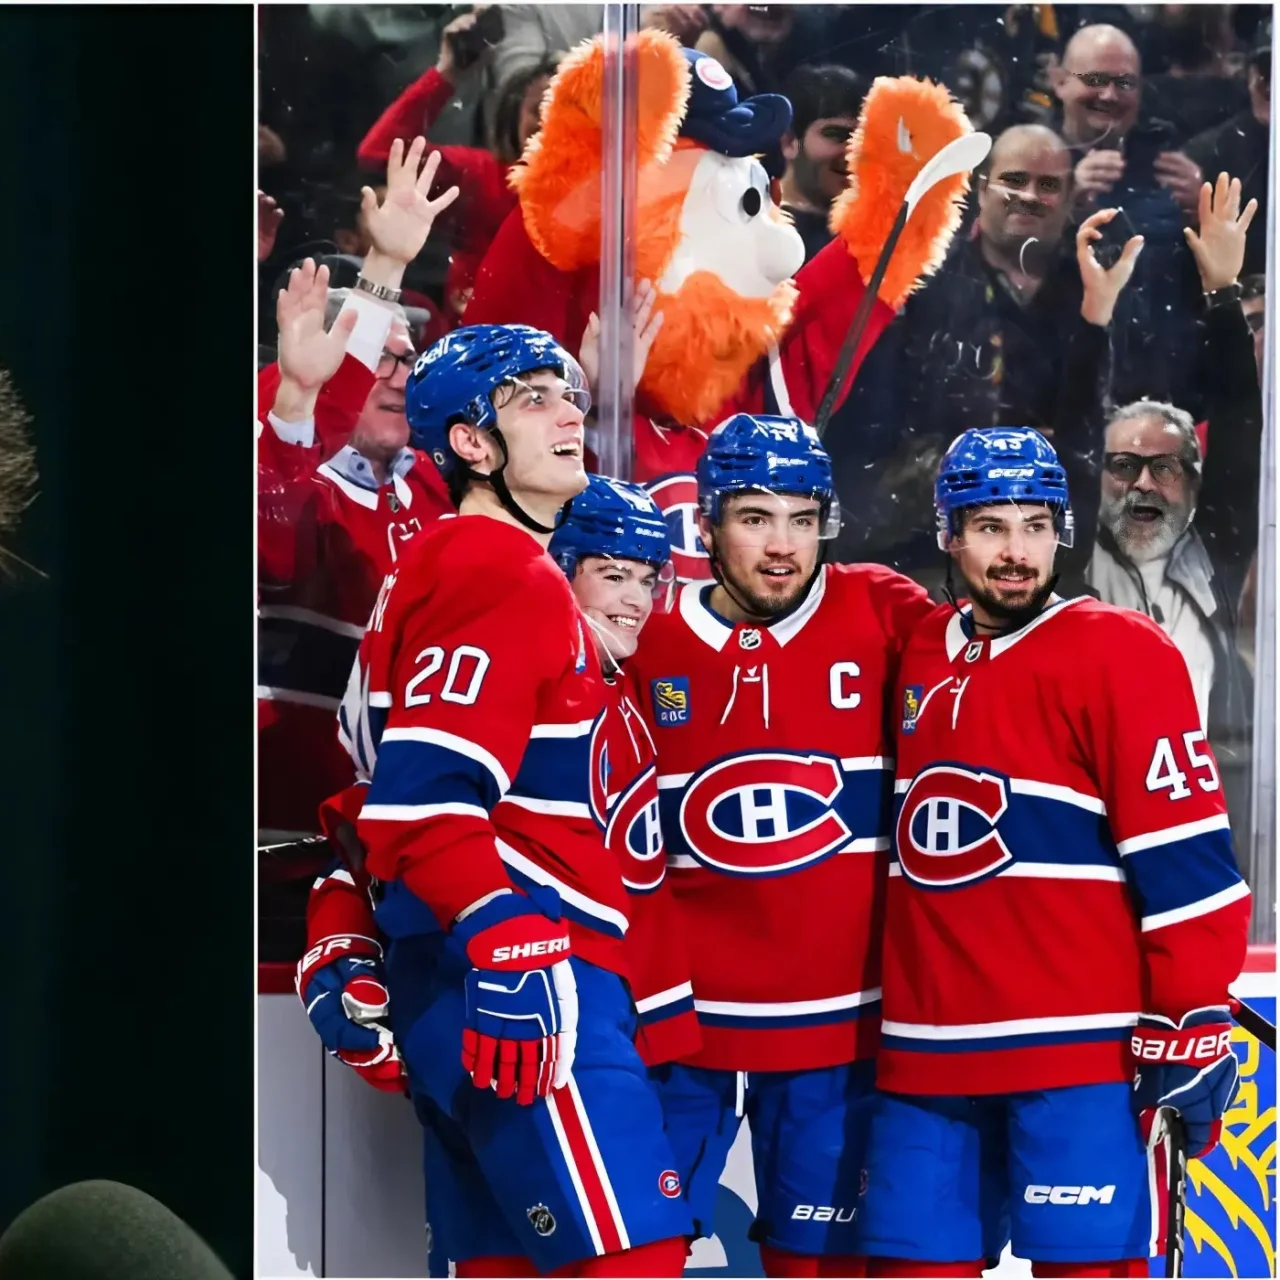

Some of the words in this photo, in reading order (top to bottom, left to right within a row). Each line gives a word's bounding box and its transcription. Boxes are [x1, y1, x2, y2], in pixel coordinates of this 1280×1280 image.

[403, 644, 491, 709] 20
[828, 660, 862, 710] C
[1144, 730, 1220, 801] 45
[1023, 1184, 1116, 1205] CCM
